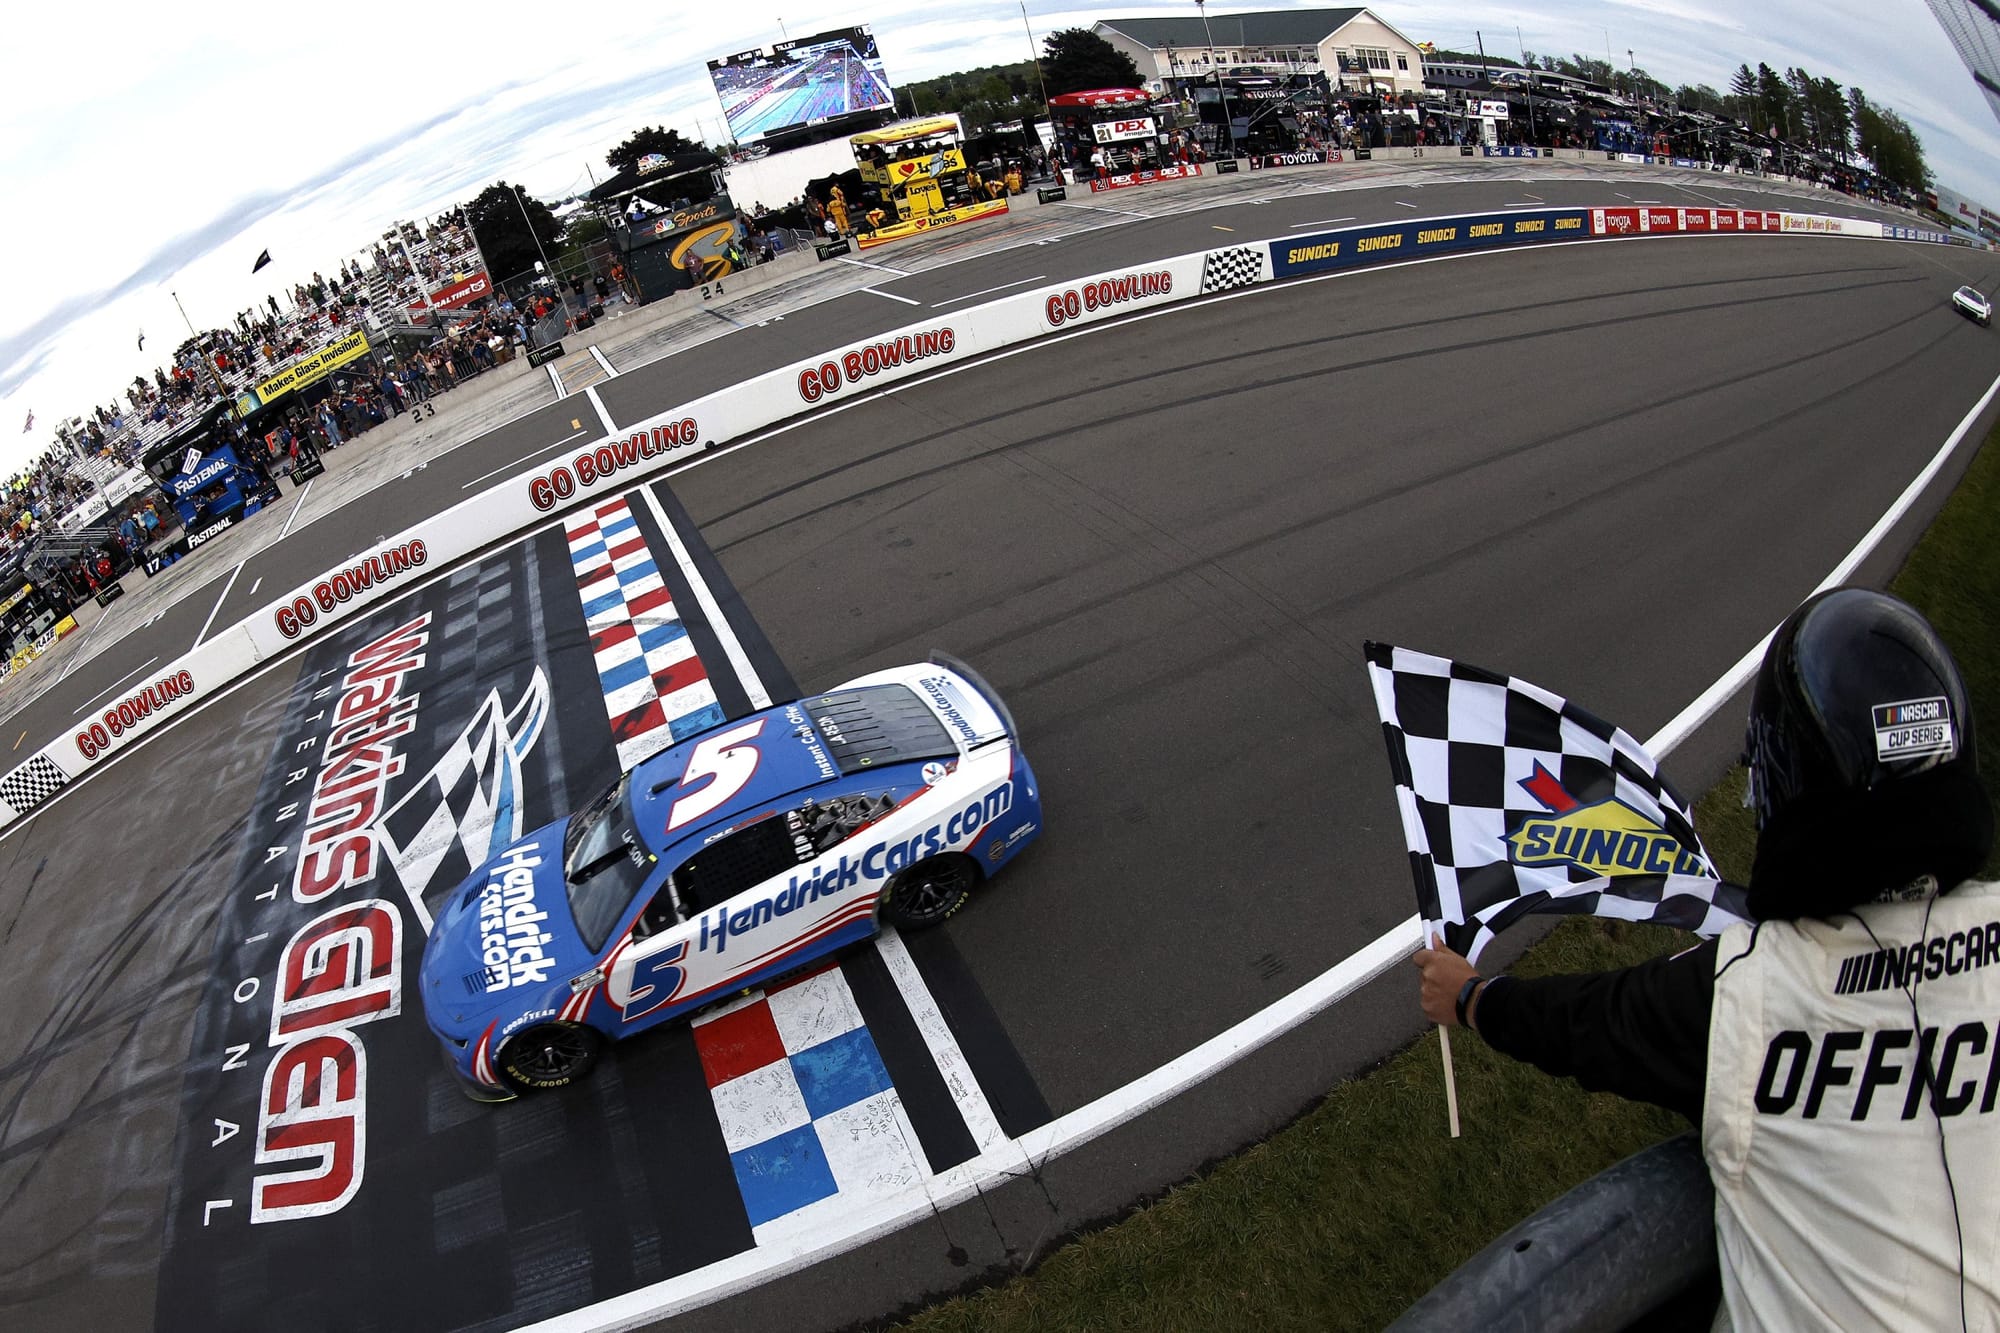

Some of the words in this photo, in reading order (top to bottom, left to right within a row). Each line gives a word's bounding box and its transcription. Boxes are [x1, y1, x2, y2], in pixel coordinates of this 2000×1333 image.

[1097, 128, 1112, 142] 21
[1115, 120, 1147, 133] DEX
[1160, 167, 1181, 176] DEX
[1281, 152, 1319, 165] TOYOTA
[910, 182, 937, 196] Love's
[1096, 178, 1110, 191] 21
[1111, 174, 1132, 184] DEX
[674, 204, 717, 227] Sports
[928, 212, 957, 226] Love's
[1607, 216, 1631, 228] TOYOTA
[1650, 215, 1671, 225] TOYOTA
[1687, 215, 1704, 224] TOYOTA
[1718, 216, 1733, 224] TOYOTA
[1288, 242, 1339, 264] SUNOCO
[1357, 234, 1402, 252] SUNOCO
[1418, 228, 1456, 244] SUNOCO
[1469, 223, 1504, 238] SUNOCO
[1515, 220, 1545, 232] SUNOCO
[1554, 218, 1582, 230] SUNOCO
[450, 286, 471, 302] TIRE
[700, 282, 724, 300] 24
[1046, 289, 1082, 327] GO
[1082, 270, 1173, 313] BOWLING
[262, 373, 295, 397] Makes
[294, 359, 321, 379] Glass
[320, 334, 363, 363] Invisible!
[798, 360, 842, 402] GO
[842, 327, 956, 383] BOWLING
[412, 402, 436, 424] 23
[174, 456, 229, 497] FASTENAL
[528, 463, 577, 512] GO
[573, 417, 698, 487] BOWLING
[187, 516, 233, 550] FASTENAL
[146, 557, 160, 574] 17
[274, 594, 318, 639] GO
[312, 538, 428, 613] BOWLING
[75, 723, 111, 761] GO
[103, 670, 195, 737] BOWLING
[785, 704, 804, 725] Offer
[919, 677, 985, 752] HendrickCars.com
[1900, 701, 1940, 723] NASCAR
[795, 723, 816, 745] Cash
[817, 716, 847, 745] LARSON
[1888, 730, 1910, 748] CUP
[1912, 726, 1944, 744] SERIES
[291, 611, 433, 904] Watkins
[807, 743, 835, 779] Instant
[664, 716, 769, 835] 5
[700, 781, 1012, 954] HendrickCars.com
[490, 842, 556, 988] Hendrick
[944, 892, 969, 919] EAGLE
[204, 666, 331, 1226] INTERNATIONAL
[1880, 921, 2000, 990] NASCAR
[622, 939, 690, 1023] 5
[502, 1008, 556, 1035] GOODYEAR
[250, 898, 401, 1225] Glen
